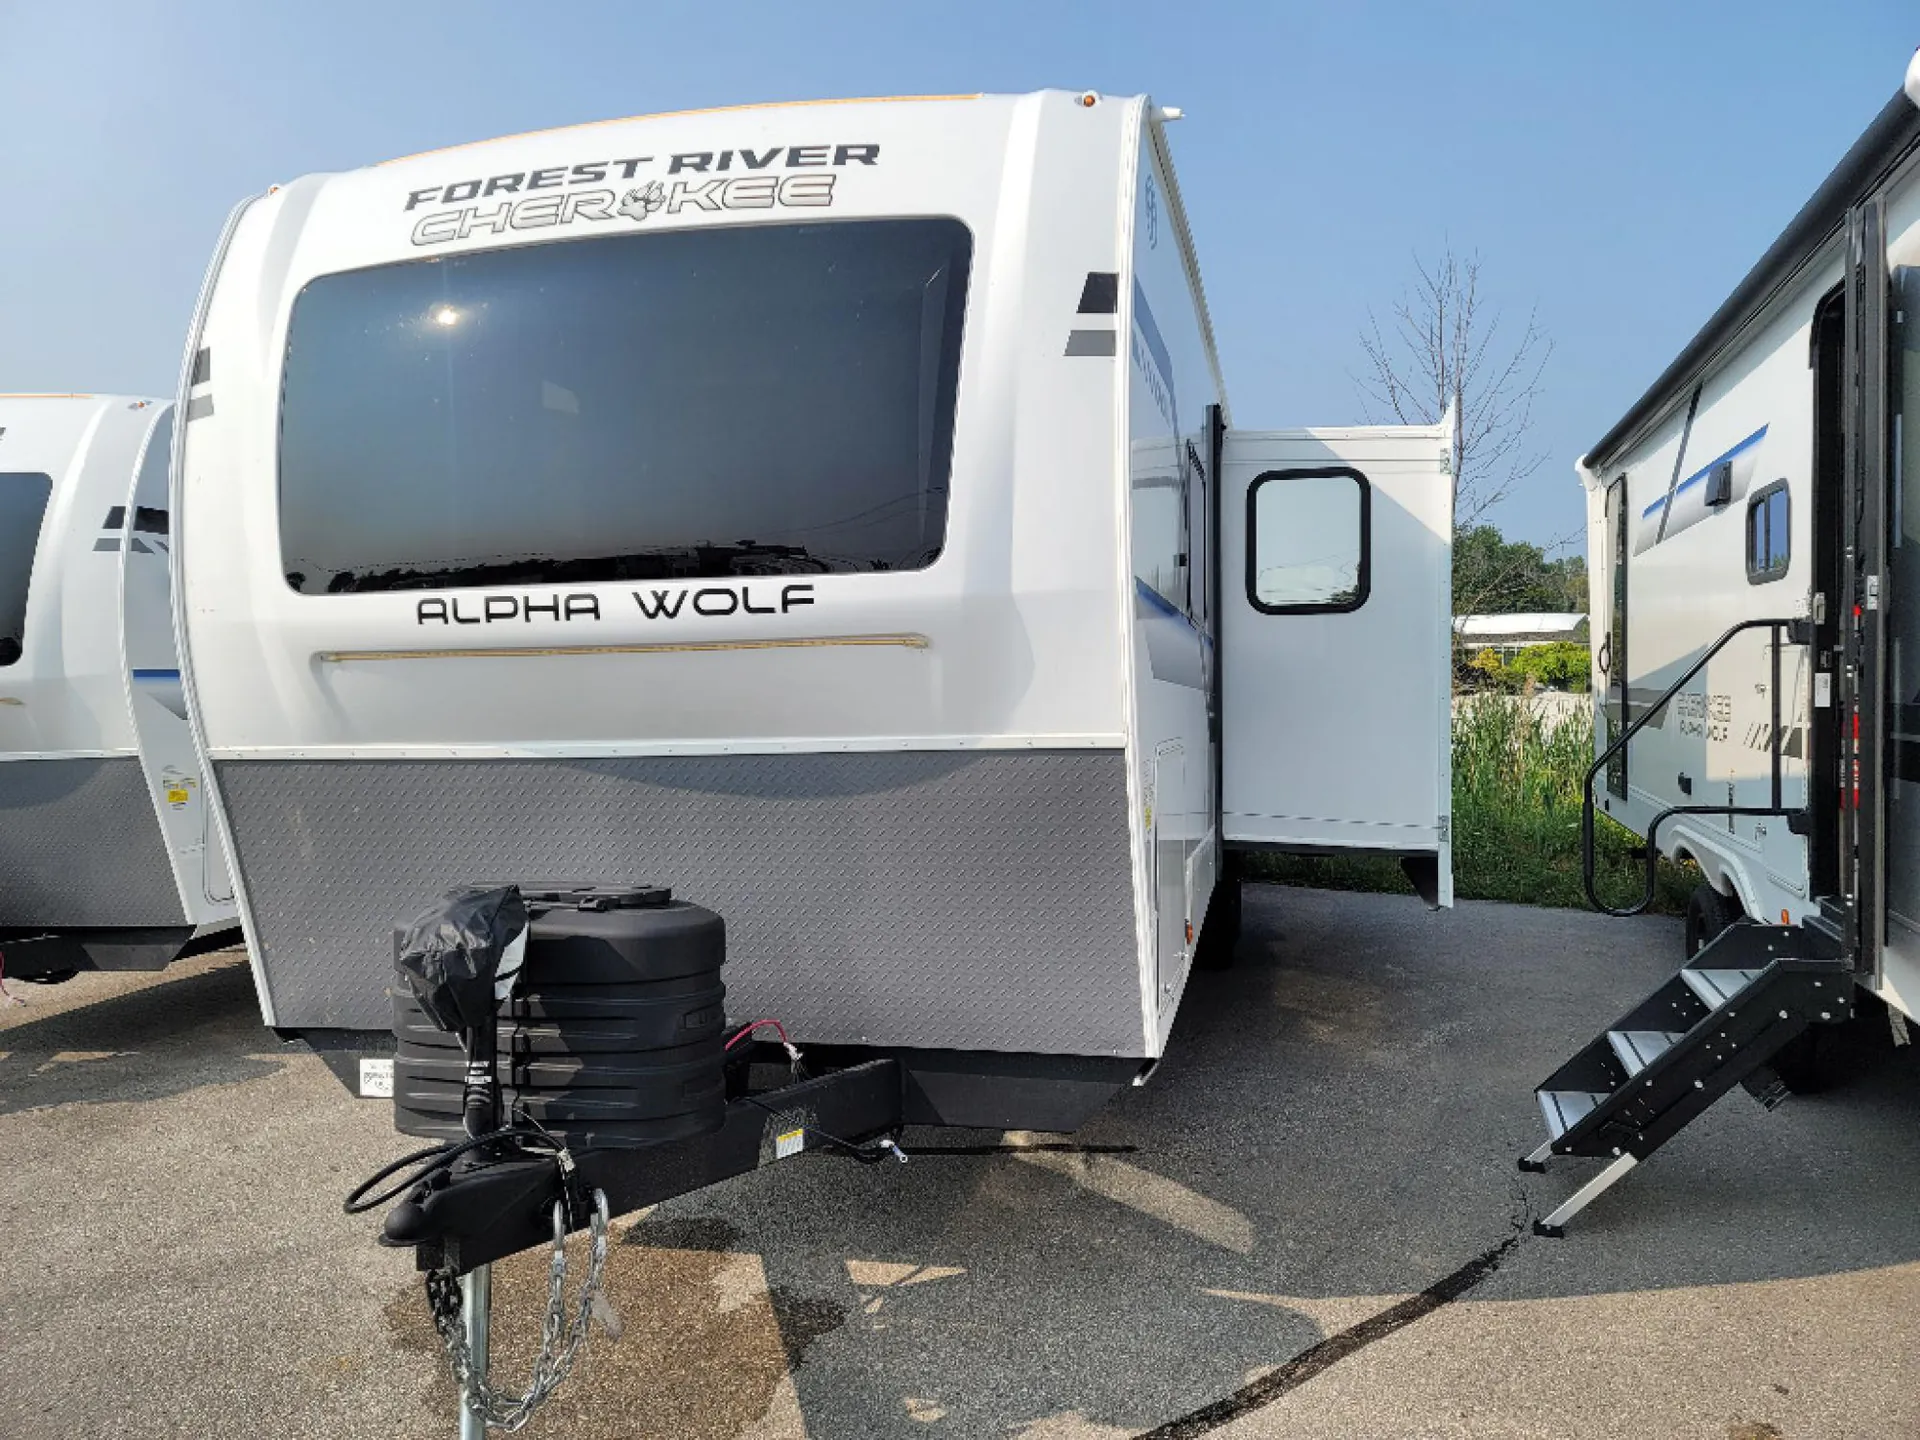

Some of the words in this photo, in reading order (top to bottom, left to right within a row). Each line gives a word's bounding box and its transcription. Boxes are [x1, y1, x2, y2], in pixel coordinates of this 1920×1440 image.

[404, 156, 653, 212] FOREST
[667, 143, 880, 175] RIVER
[417, 592, 601, 626] ALPHA
[632, 584, 815, 620] WOLF
